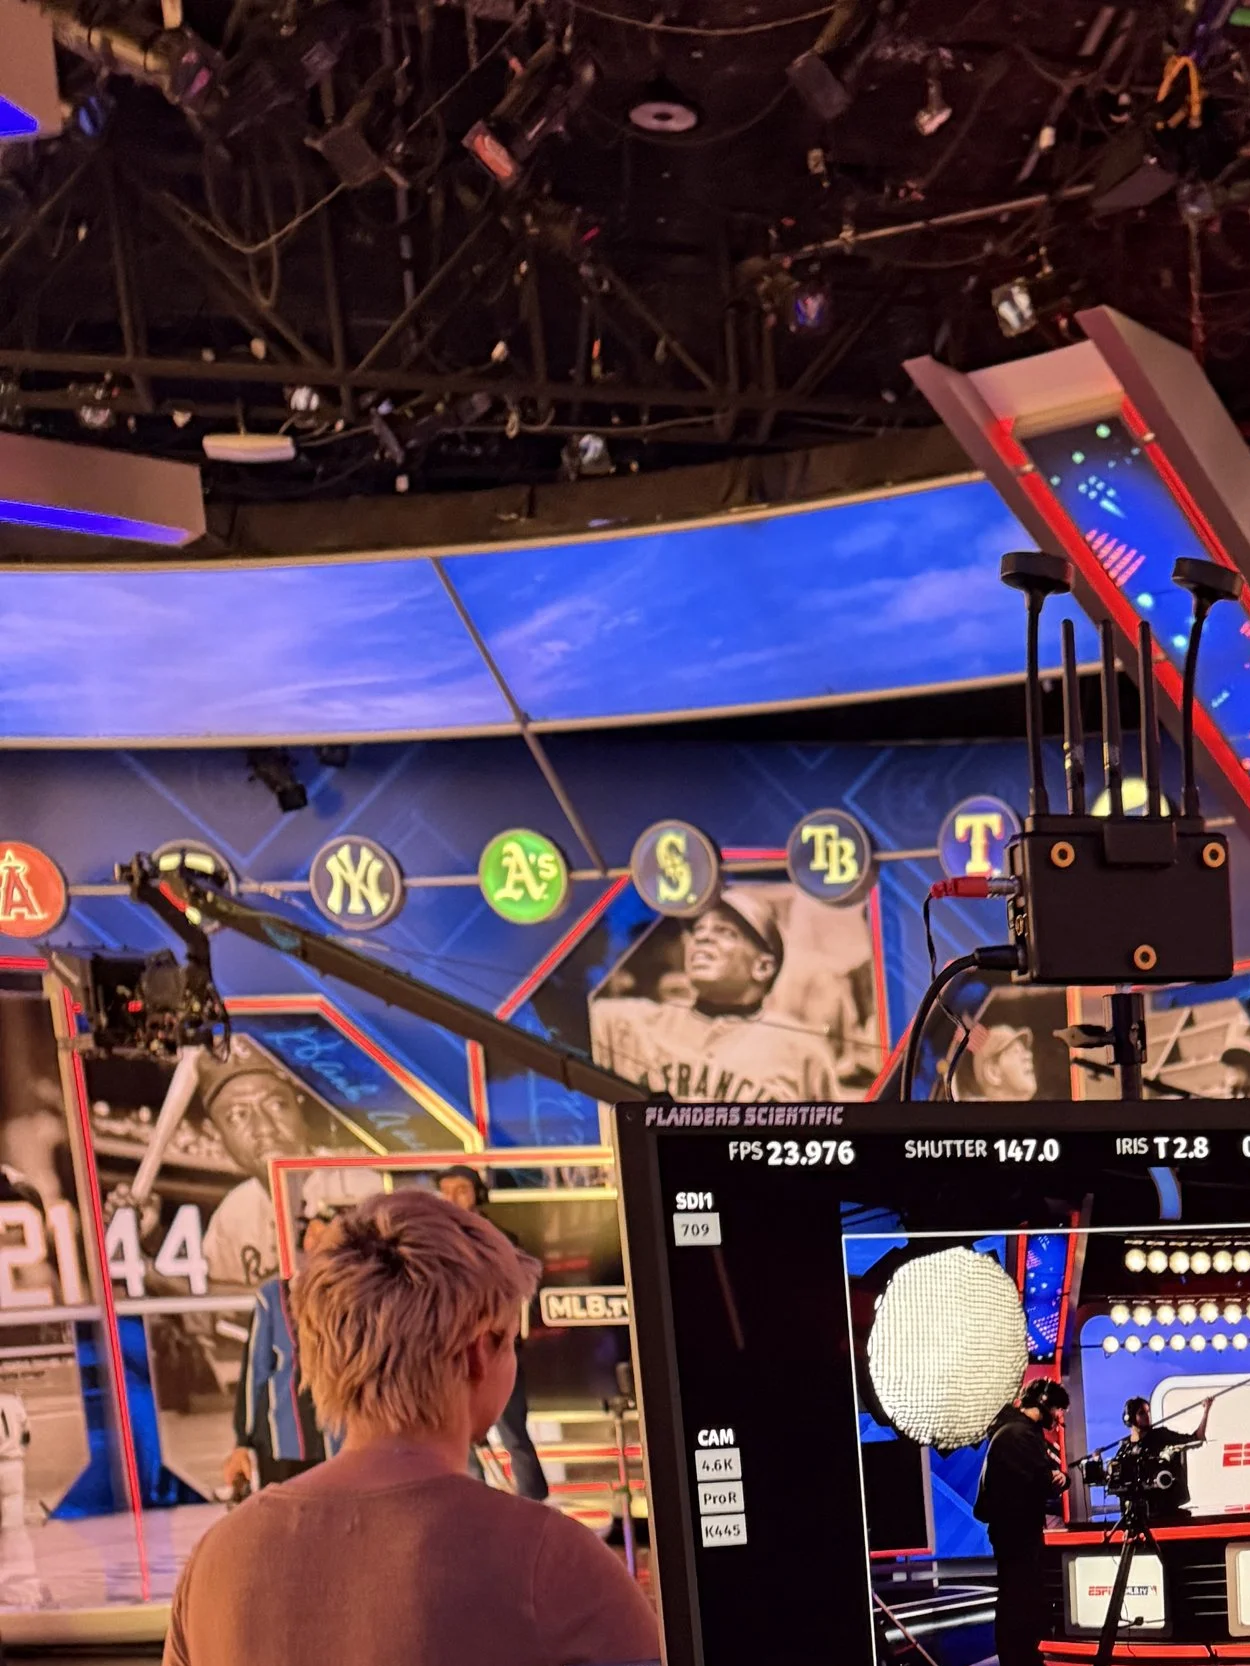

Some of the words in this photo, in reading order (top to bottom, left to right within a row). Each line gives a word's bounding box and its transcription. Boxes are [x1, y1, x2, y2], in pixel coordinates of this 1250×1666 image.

[324, 842, 390, 917] NY
[495, 844, 559, 904] A's
[645, 1107, 741, 1127] FLANDERS
[744, 1106, 844, 1127] SCIENTIFIC
[729, 1141, 764, 1162] FPS
[767, 1141, 855, 1166] 23.976
[904, 1139, 988, 1160] SHUTTER
[994, 1138, 1060, 1163] 147.0
[1115, 1137, 1149, 1156] IRIS
[1173, 1136, 1209, 1159] 2.8
[675, 1192, 713, 1211] SDI1
[681, 1221, 711, 1238] 709
[0, 1200, 84, 1307] 21
[104, 1204, 209, 1297] 44
[697, 1428, 735, 1447] CAM
[702, 1458, 733, 1472] 4.6K
[703, 1491, 737, 1506] ProR
[1088, 1585, 1115, 1596] ESP
